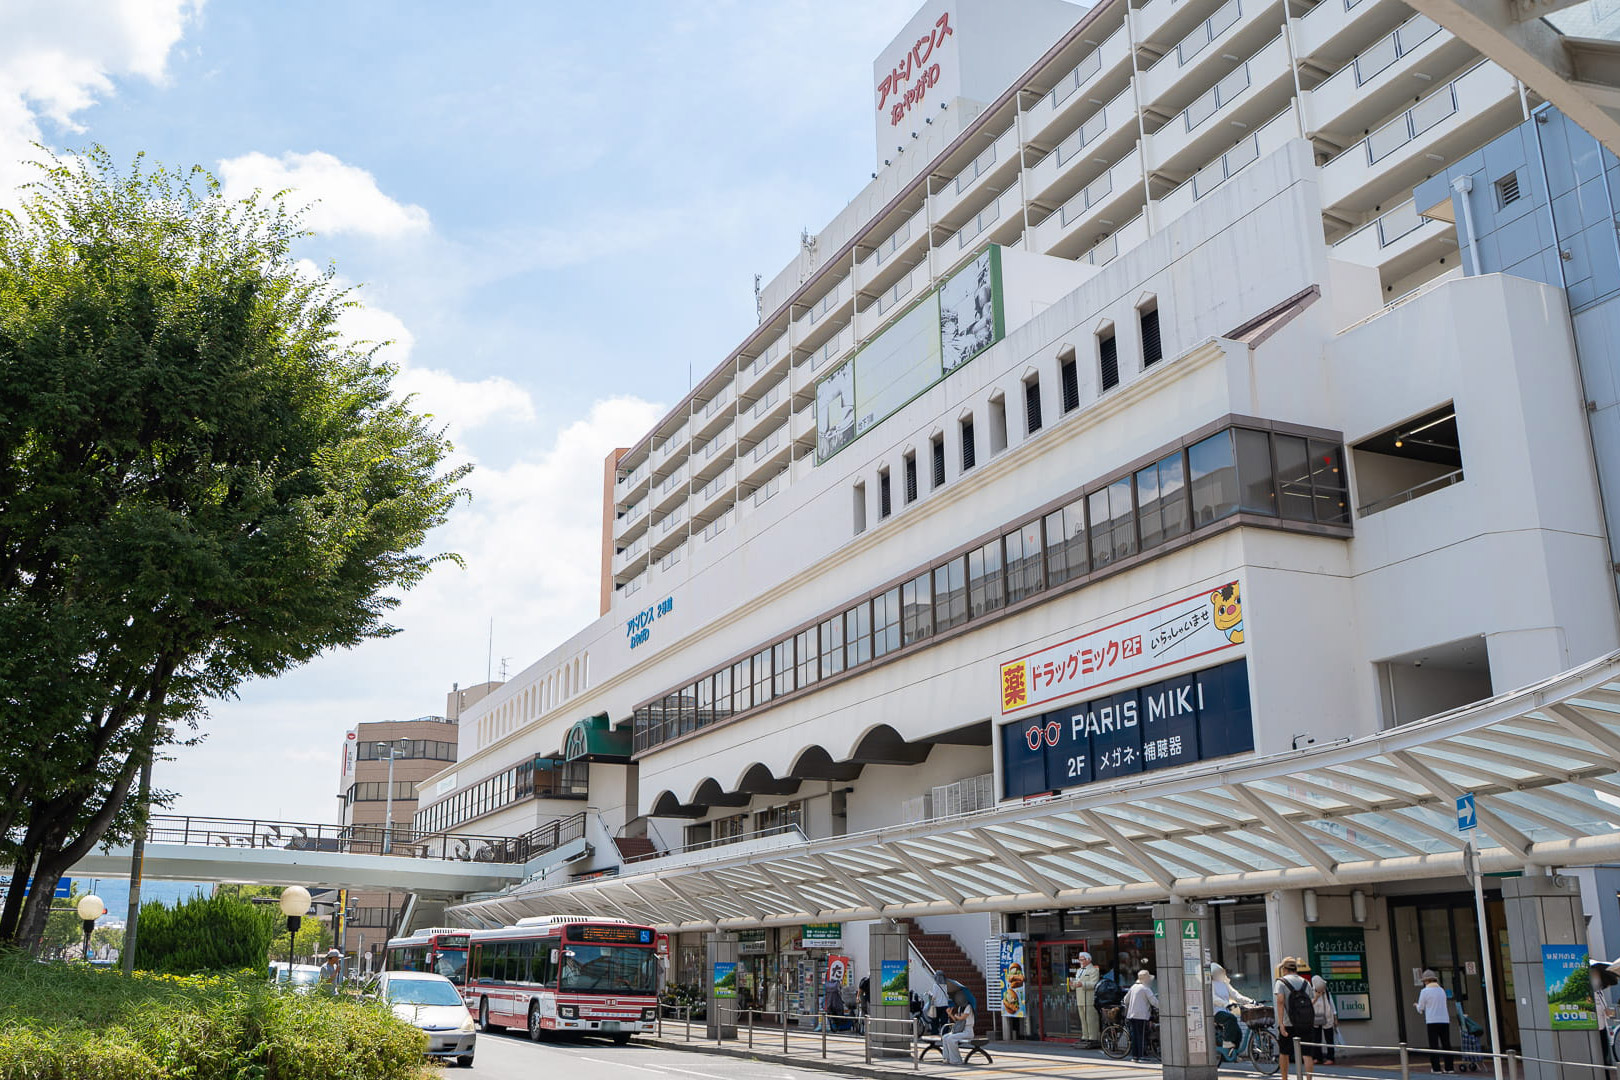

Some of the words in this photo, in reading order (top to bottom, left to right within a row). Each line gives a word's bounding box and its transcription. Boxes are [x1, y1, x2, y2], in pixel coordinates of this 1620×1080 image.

[878, 12, 953, 111] アドバンス
[891, 63, 940, 126] ねやがわ
[1150, 610, 1210, 650] いらっしゃいませ
[1031, 639, 1120, 692] ドラッグミック
[1122, 635, 1142, 659] 2F
[1003, 664, 1027, 706] 薬
[1071, 700, 1138, 741] PARIS
[1148, 682, 1205, 722] MIKI
[1067, 755, 1085, 777] 2F
[1100, 735, 1182, 771] メガネ・補聴器
[1155, 921, 1164, 937] 4
[1184, 921, 1196, 938] 4
